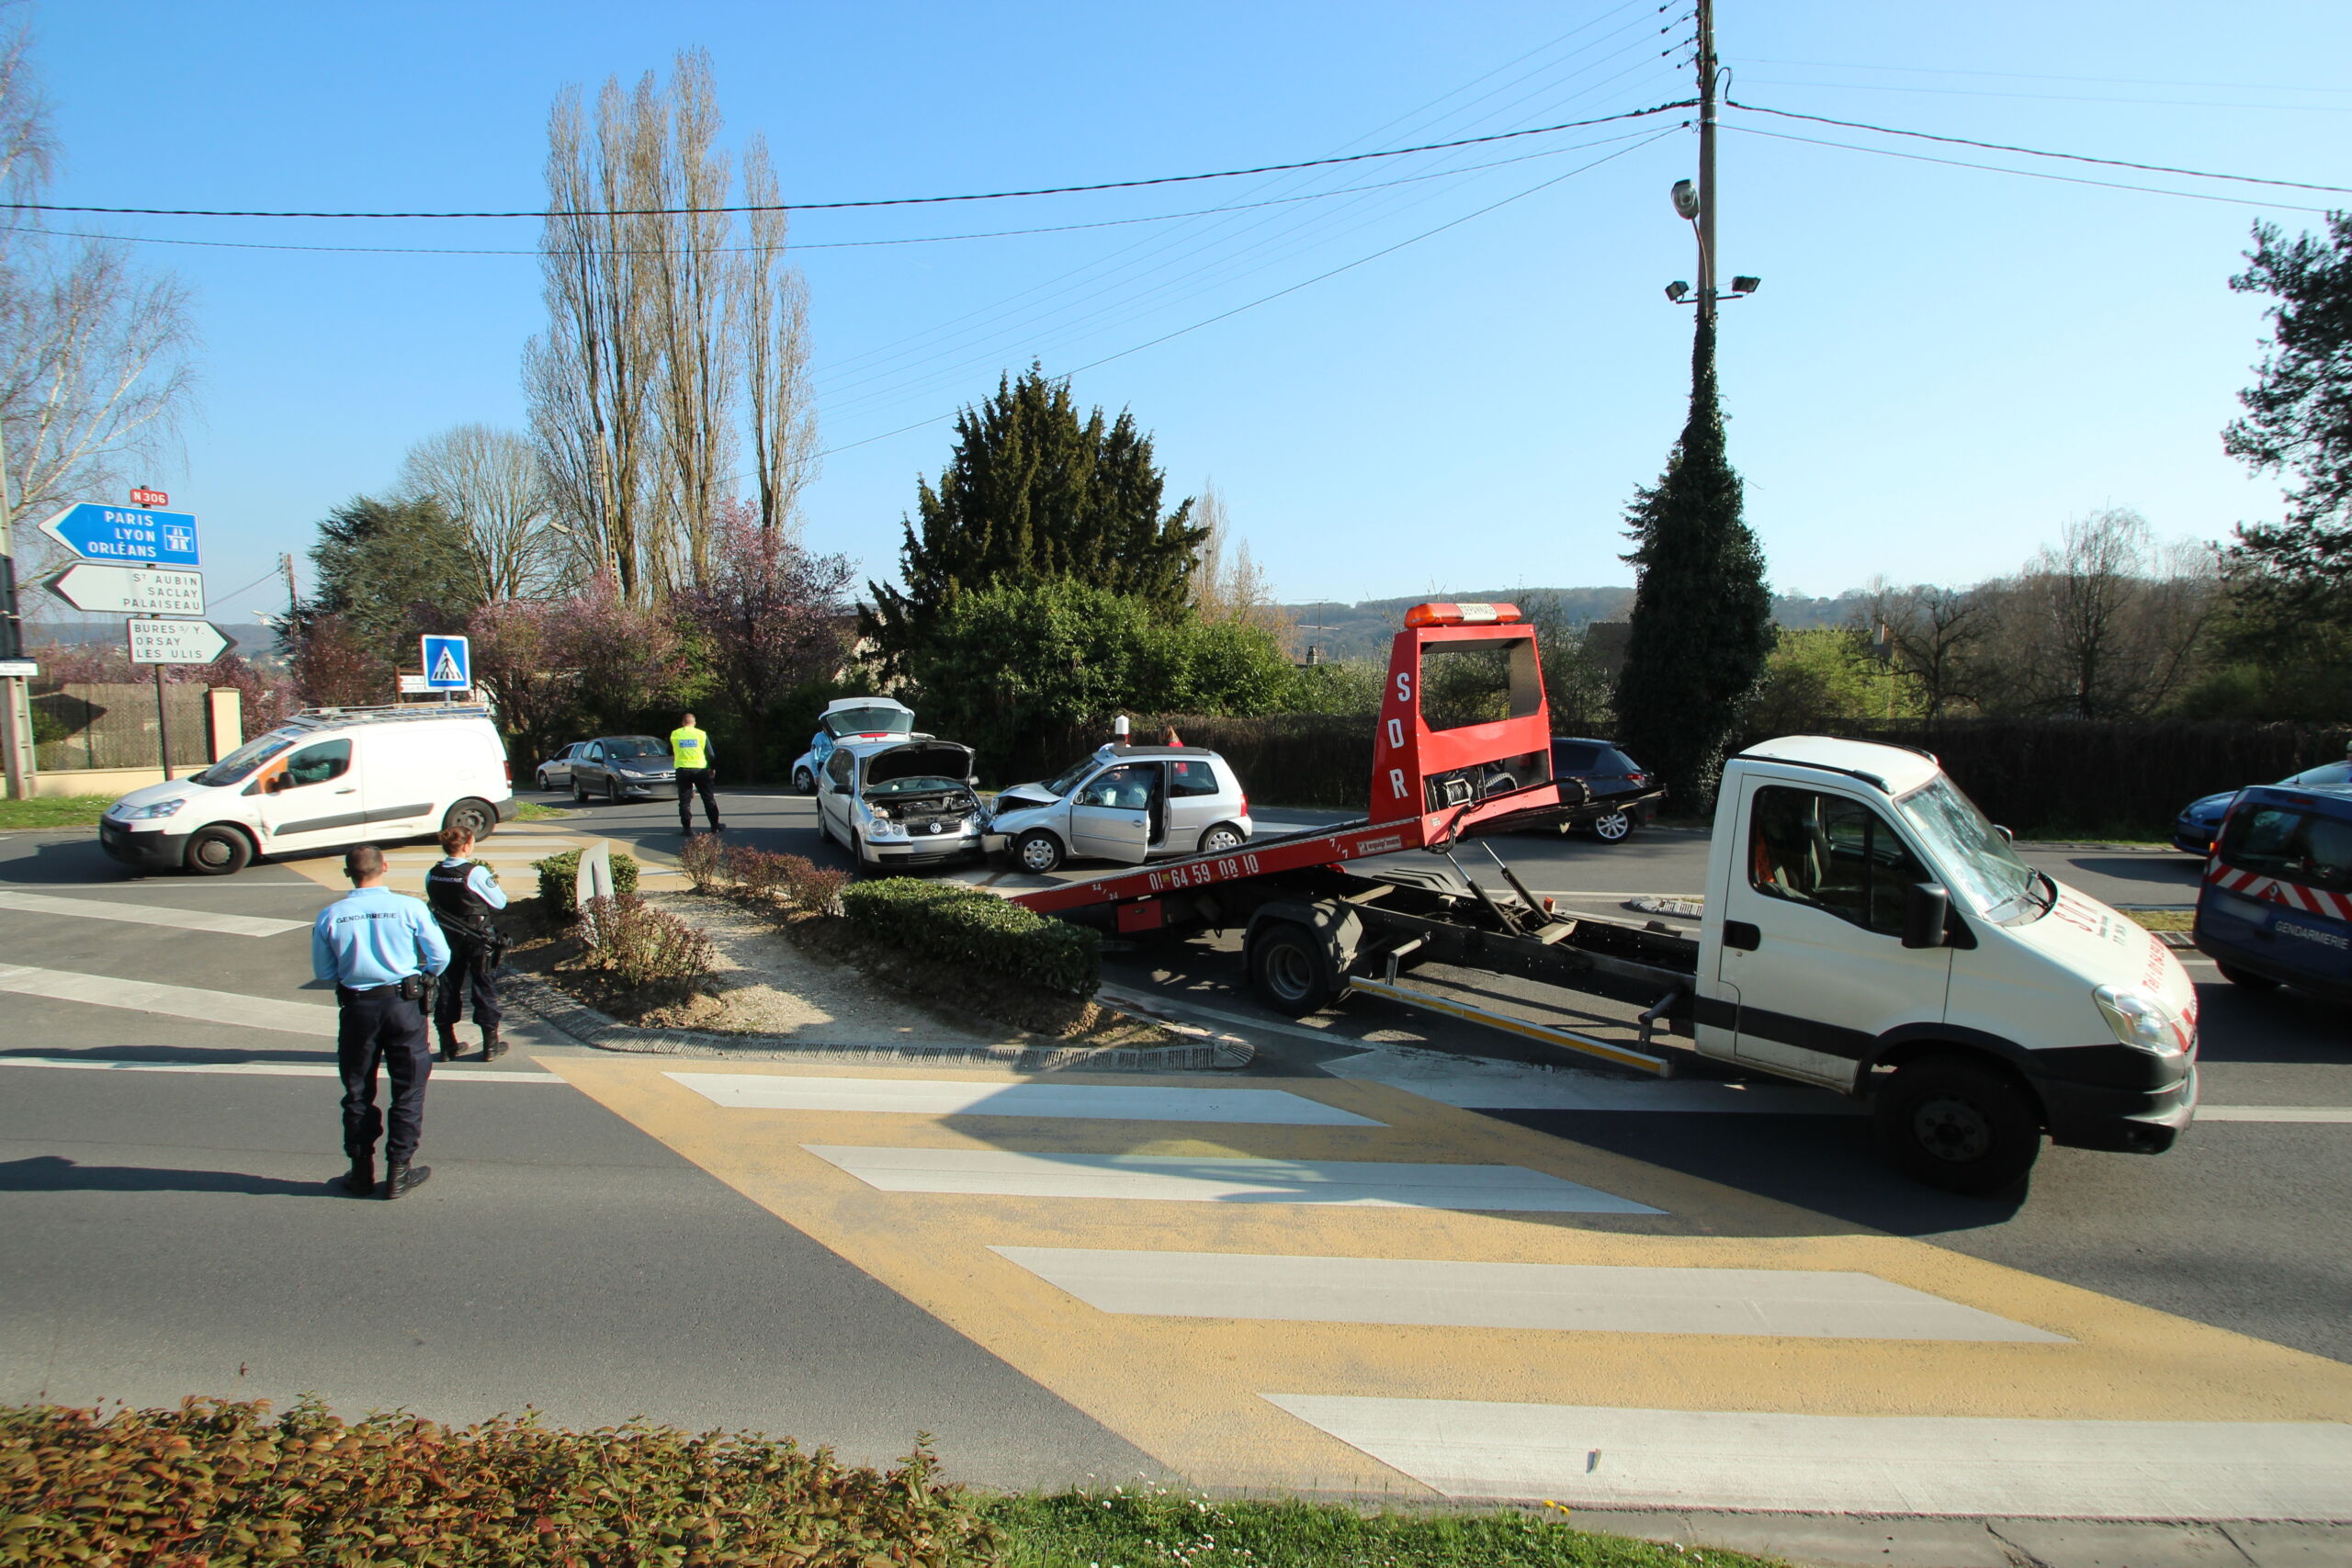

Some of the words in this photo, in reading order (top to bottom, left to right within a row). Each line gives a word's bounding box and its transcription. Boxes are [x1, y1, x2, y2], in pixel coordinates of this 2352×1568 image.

[133, 491, 141, 501] N
[143, 492, 166, 503] 306
[104, 511, 154, 526] PARIS
[115, 527, 156, 542] LYON
[88, 541, 157, 558] ORLÉANS
[155, 575, 198, 586] AUBIN
[147, 587, 198, 598] SACLAY
[123, 598, 200, 610] PALAISEAU
[134, 625, 176, 634] BURES
[136, 637, 181, 646] ORSAY
[136, 649, 162, 658] LES
[171, 649, 203, 659] ULIS
[1171, 867, 1189, 888] 64
[1192, 863, 1211, 884] 59
[1218, 859, 1238, 879] 08
[336, 912, 398, 924] GENDARMERIE
[2275, 921, 2349, 950] GENDARMERIE
